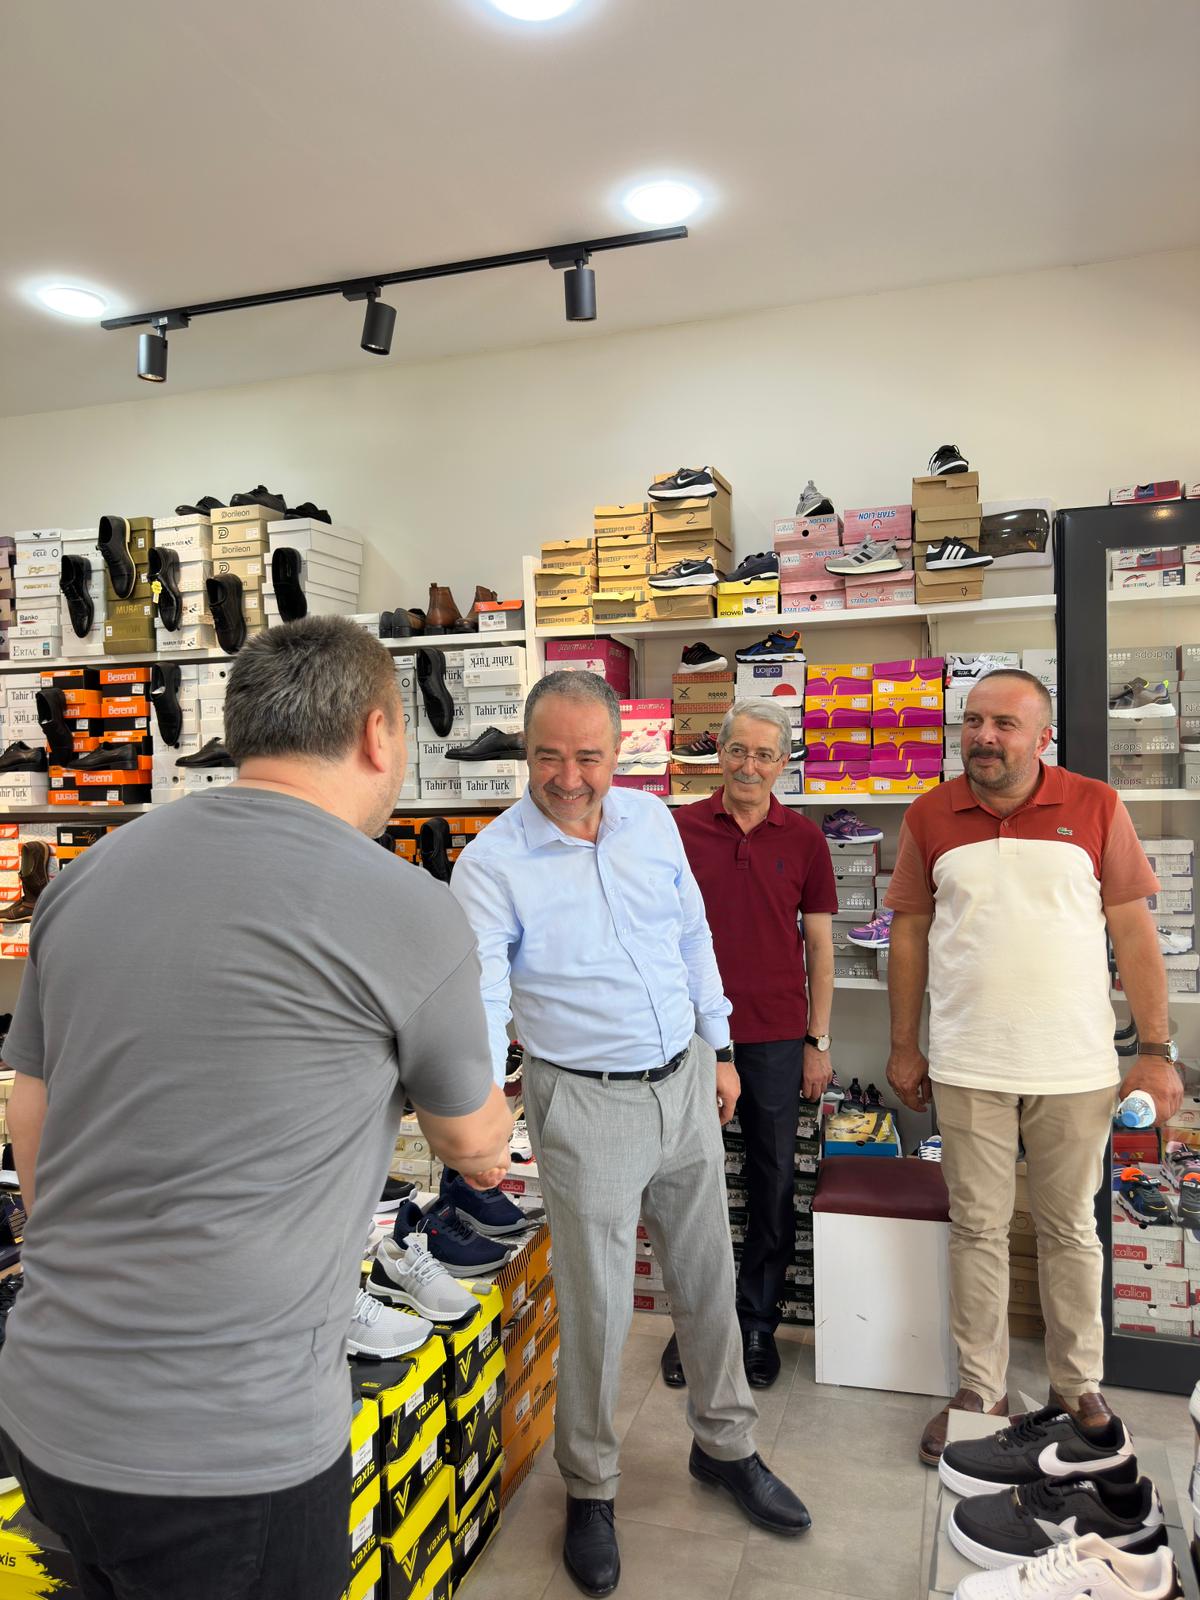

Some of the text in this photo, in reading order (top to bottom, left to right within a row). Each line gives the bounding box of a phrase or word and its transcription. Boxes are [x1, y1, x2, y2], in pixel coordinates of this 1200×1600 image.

[857, 509, 896, 520] STAR LION
[470, 655, 514, 668] Tahir Türk
[107, 671, 137, 682] Berenni
[12, 690, 31, 701] Tahir
[108, 705, 138, 715] Berenni
[475, 704, 518, 716] Tahir Türk
[423, 744, 444, 754] Tahir
[83, 773, 113, 783] Berenni
[425, 780, 446, 791] Tahir
[466, 779, 510, 791] Tahir Türk
[1118, 1285, 1149, 1299] callion
[482, 1335, 499, 1360] vaxis
[415, 1392, 439, 1421] vaxis
[351, 1460, 376, 1494] vaxis
[423, 1456, 443, 1486] vaxis
[426, 1524, 448, 1556] vaxis
[351, 1534, 377, 1570] vaxis
[0, 1552, 17, 1568] xis
